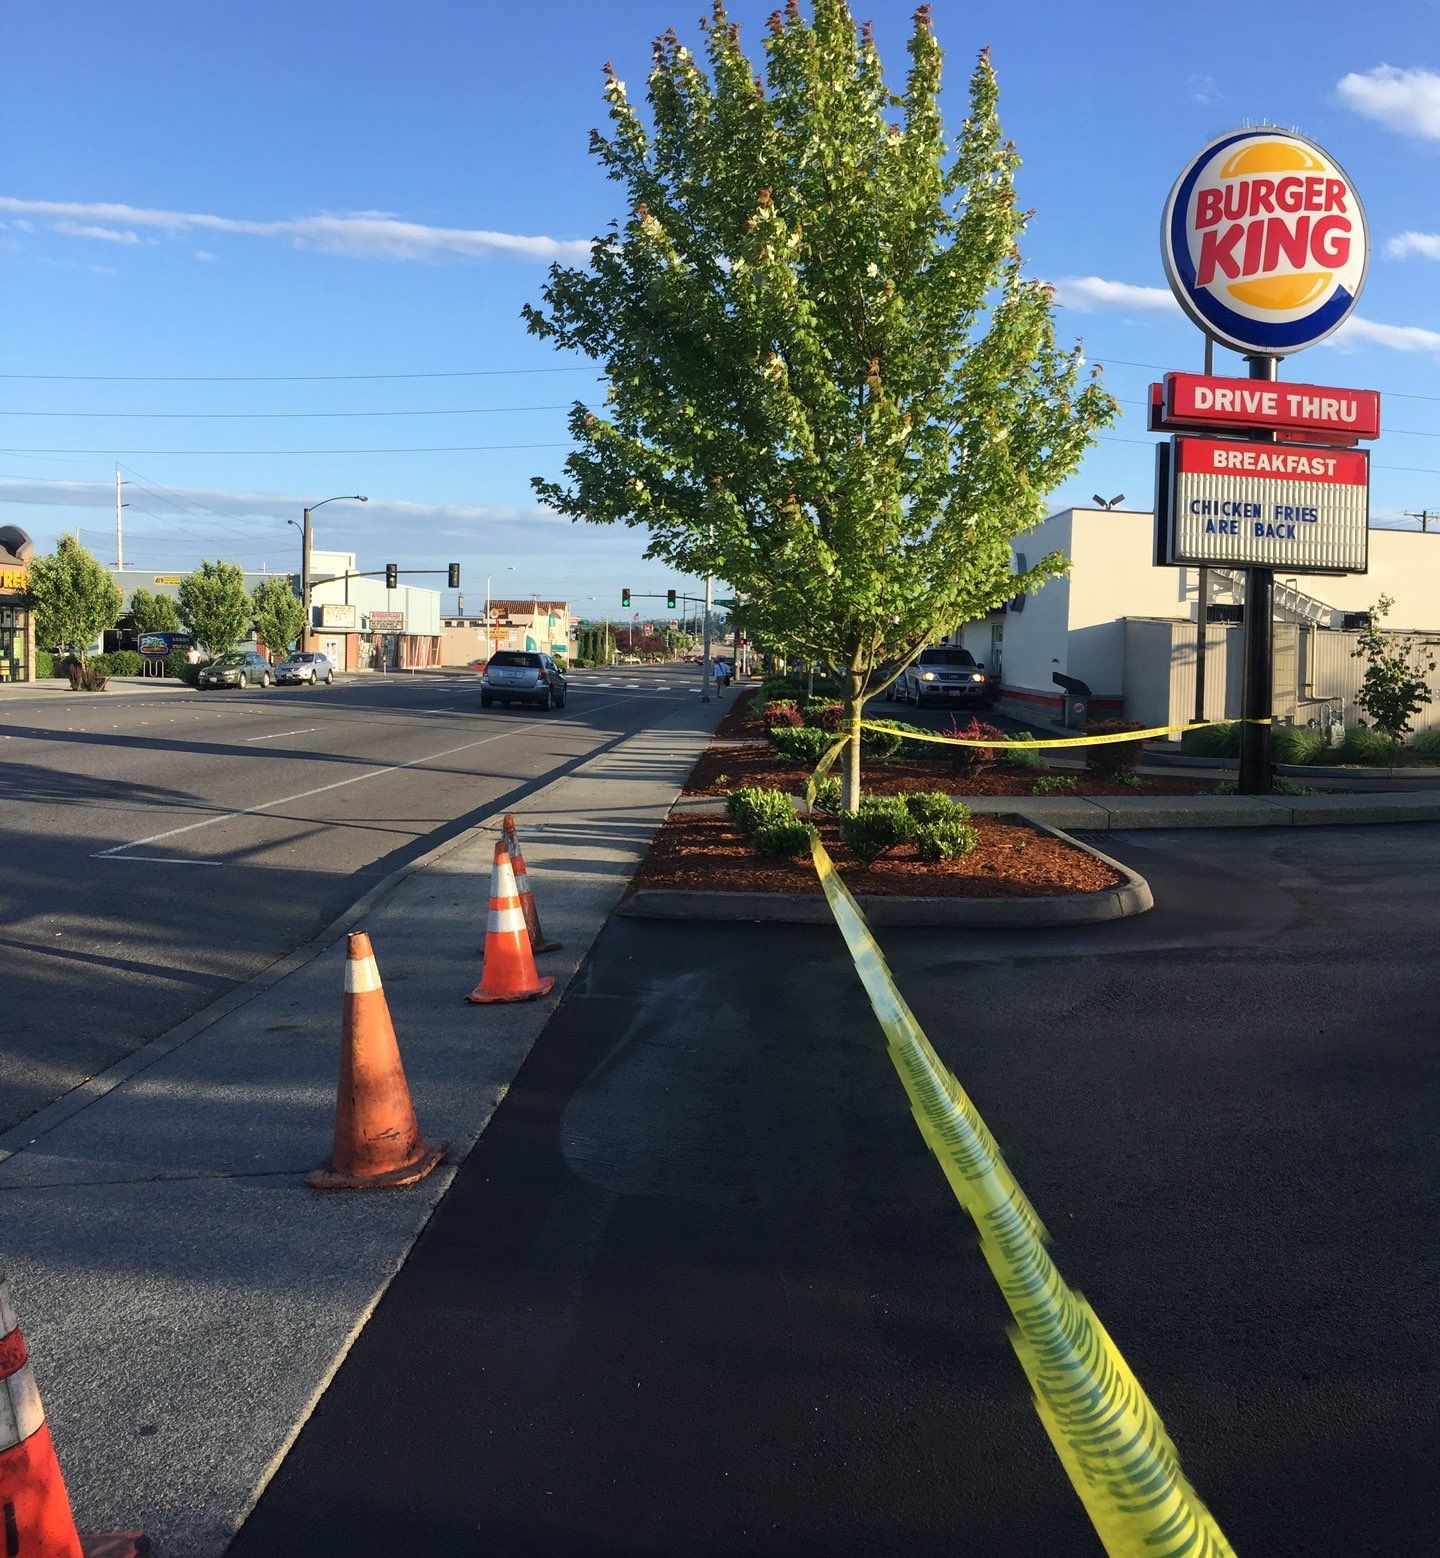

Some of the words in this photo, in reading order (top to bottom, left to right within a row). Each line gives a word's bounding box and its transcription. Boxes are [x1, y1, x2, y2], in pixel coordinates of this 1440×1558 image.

[1195, 176, 1347, 230] BURGER
[1196, 214, 1352, 287] KING
[1194, 386, 1278, 416] DRIVE
[1286, 394, 1358, 423] THRU
[1213, 449, 1337, 476] BREAKFAST
[1190, 499, 1262, 519] CHICKEN
[1274, 505, 1318, 523] FRIES
[1205, 519, 1239, 535] ARE
[1254, 523, 1297, 540] BACK
